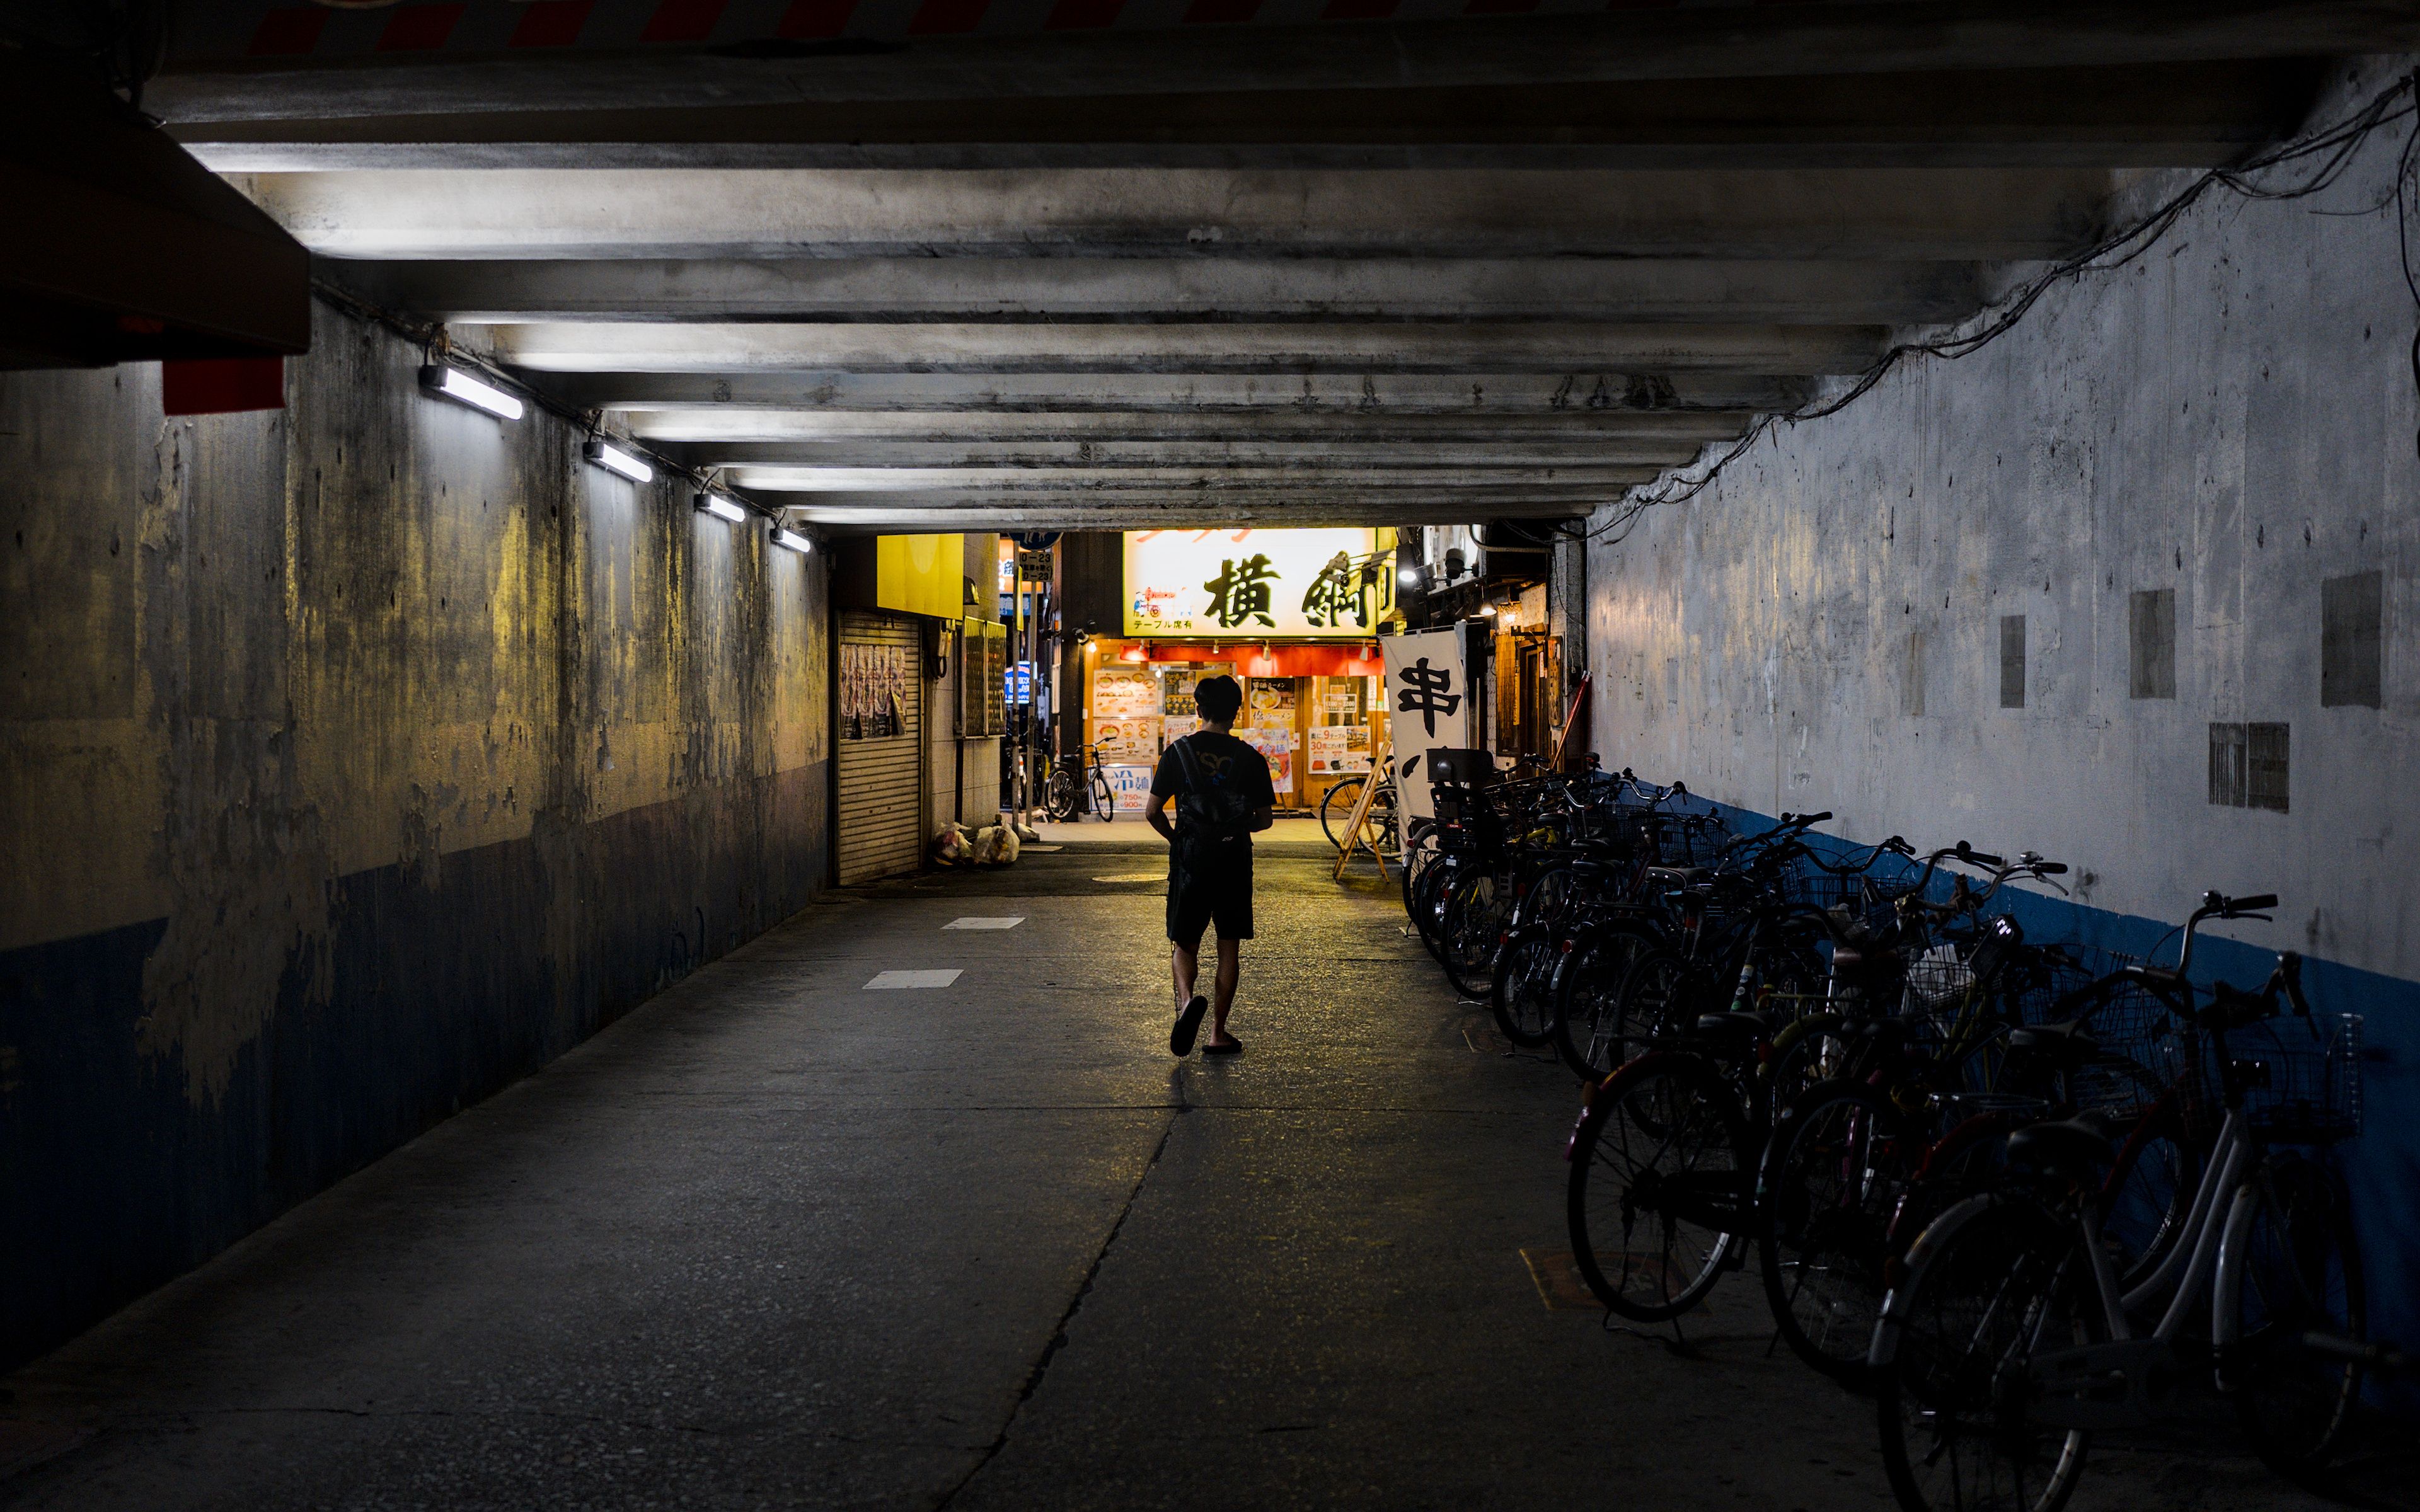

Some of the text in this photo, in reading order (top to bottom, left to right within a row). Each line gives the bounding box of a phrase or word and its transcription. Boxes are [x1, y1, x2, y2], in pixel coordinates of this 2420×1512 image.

[1134, 620, 1192, 629] テーブル席有
[1398, 657, 1461, 779] 串
[1114, 770, 1149, 791] 冷麺
